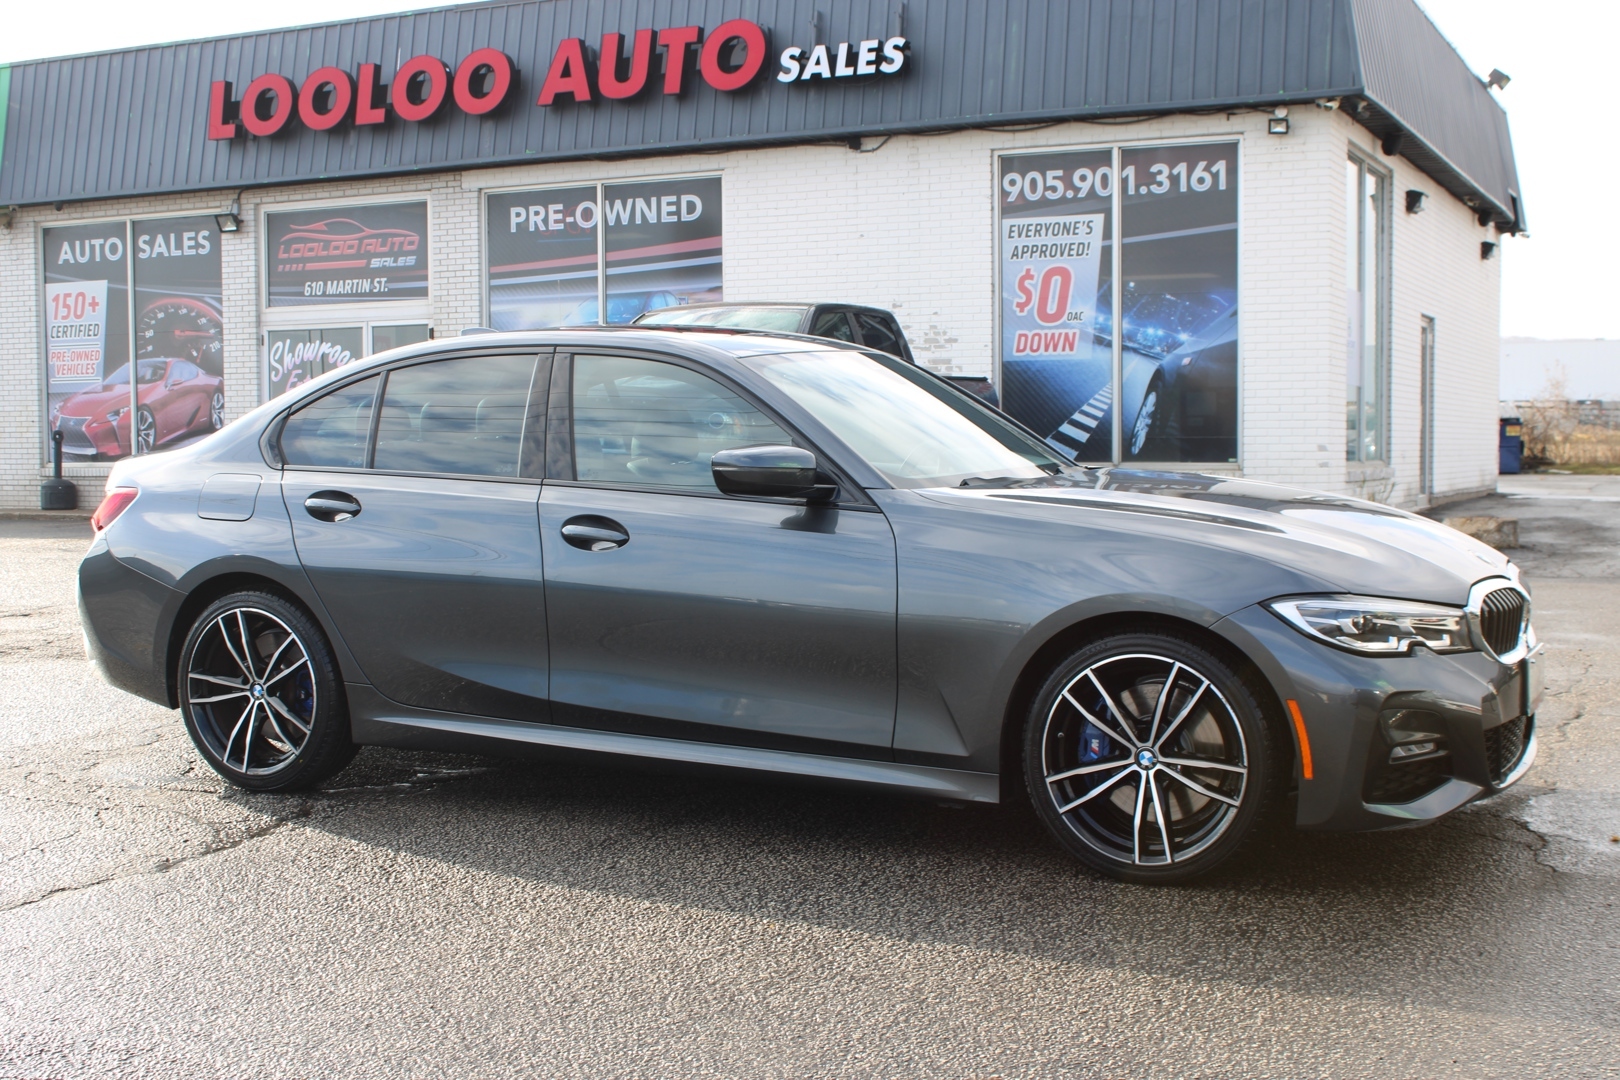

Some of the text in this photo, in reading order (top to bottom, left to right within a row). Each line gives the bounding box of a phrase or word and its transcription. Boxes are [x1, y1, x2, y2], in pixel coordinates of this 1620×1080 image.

[208, 18, 906, 141] LOOLOO AUTO SALES
[1002, 160, 1227, 202] 905.901.3161
[510, 194, 703, 233] PRE-OWNED
[1007, 219, 1094, 239] EVERYONE'S
[57, 230, 211, 265] AUTO SALES
[277, 236, 420, 259] LOOLOO AUTO
[1010, 241, 1091, 260] APPROVED!
[370, 255, 417, 268] SALES
[304, 277, 388, 296] 610 MARTIN ST.
[1015, 265, 1073, 324] $0
[51, 291, 100, 321] 150+
[1066, 311, 1084, 322] OAC
[50, 323, 100, 339] CERTIFIED
[1015, 331, 1077, 354] DOWN
[50, 350, 100, 362] PRE-OWNED
[270, 338, 357, 382] Showroo
[56, 363, 96, 376] VEHICLES
